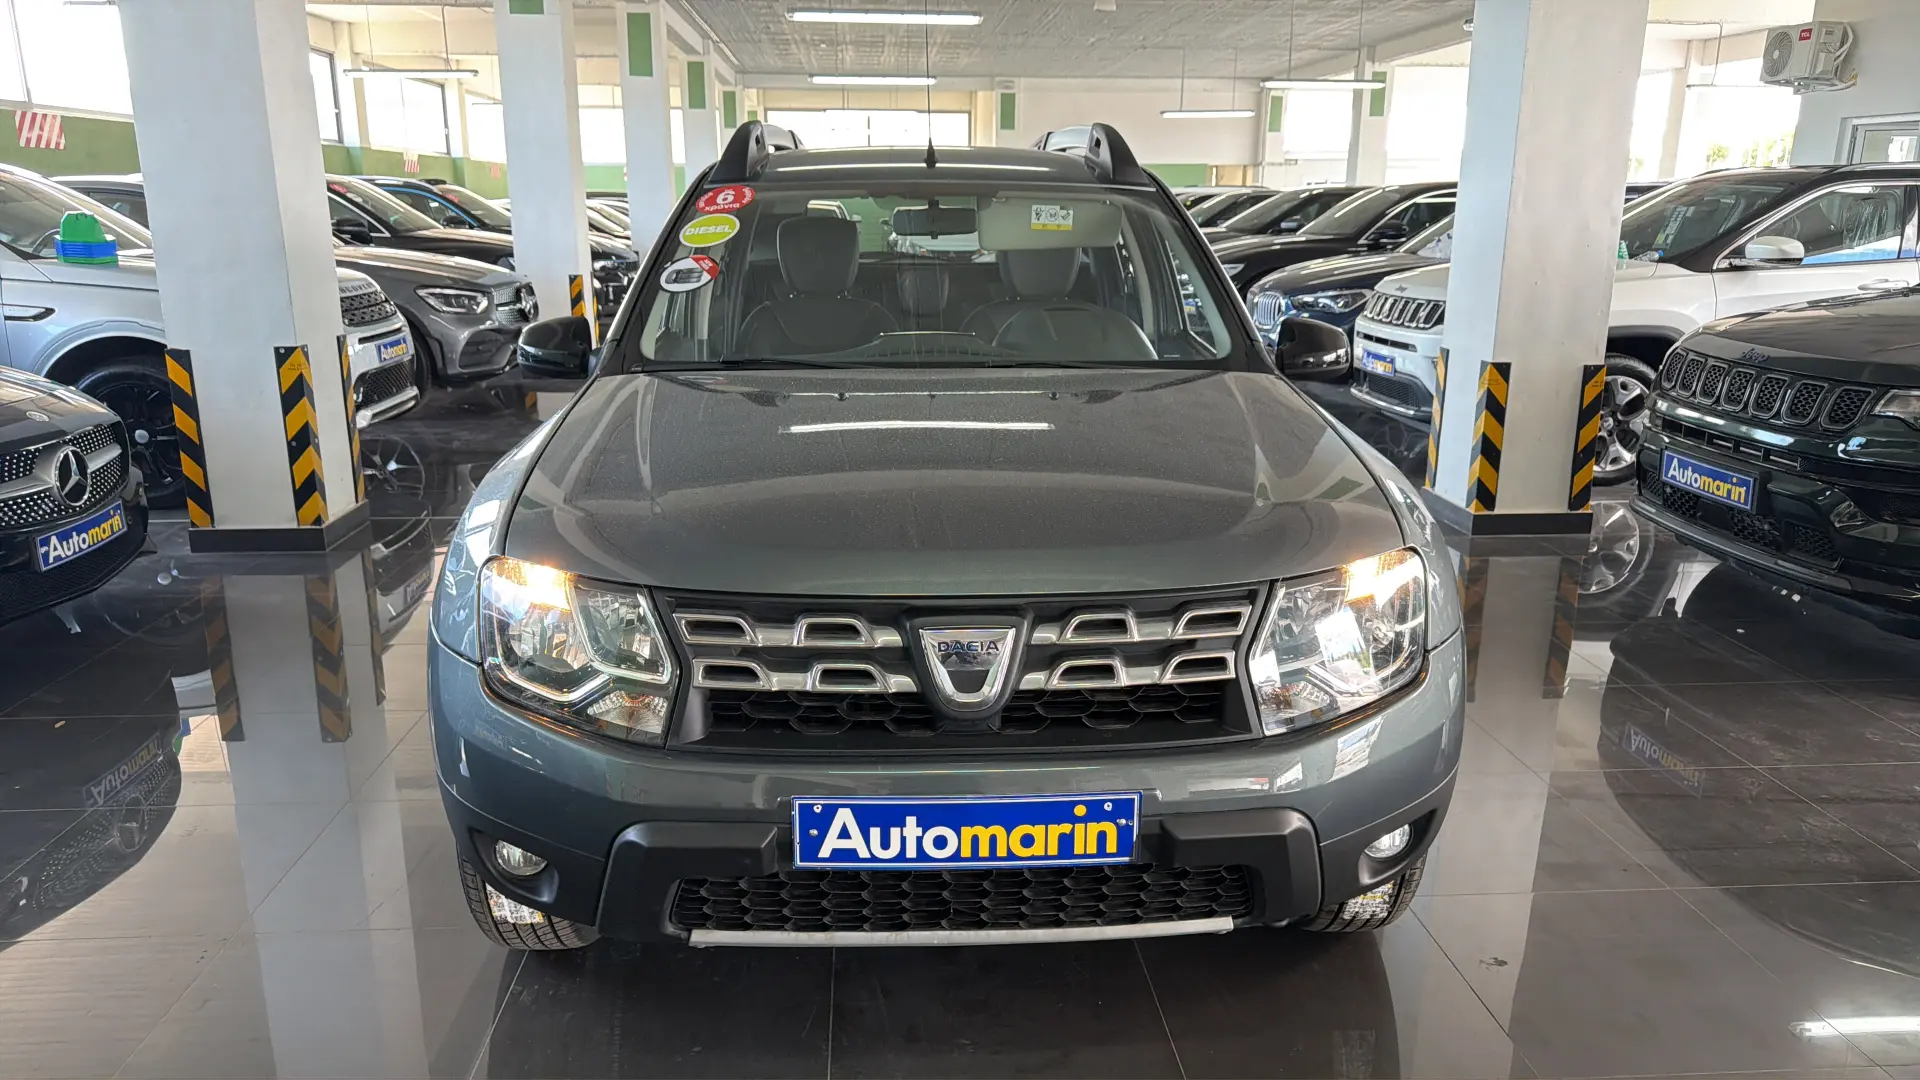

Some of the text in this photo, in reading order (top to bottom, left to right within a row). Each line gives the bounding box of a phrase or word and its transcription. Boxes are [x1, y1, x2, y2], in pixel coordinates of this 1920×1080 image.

[716, 190, 736, 205] 6
[685, 225, 733, 236] DIESEL
[1668, 457, 1746, 503] Automarin
[49, 509, 122, 564] Automarin
[938, 640, 1000, 652] DACIA
[818, 804, 1117, 859] Automarin
